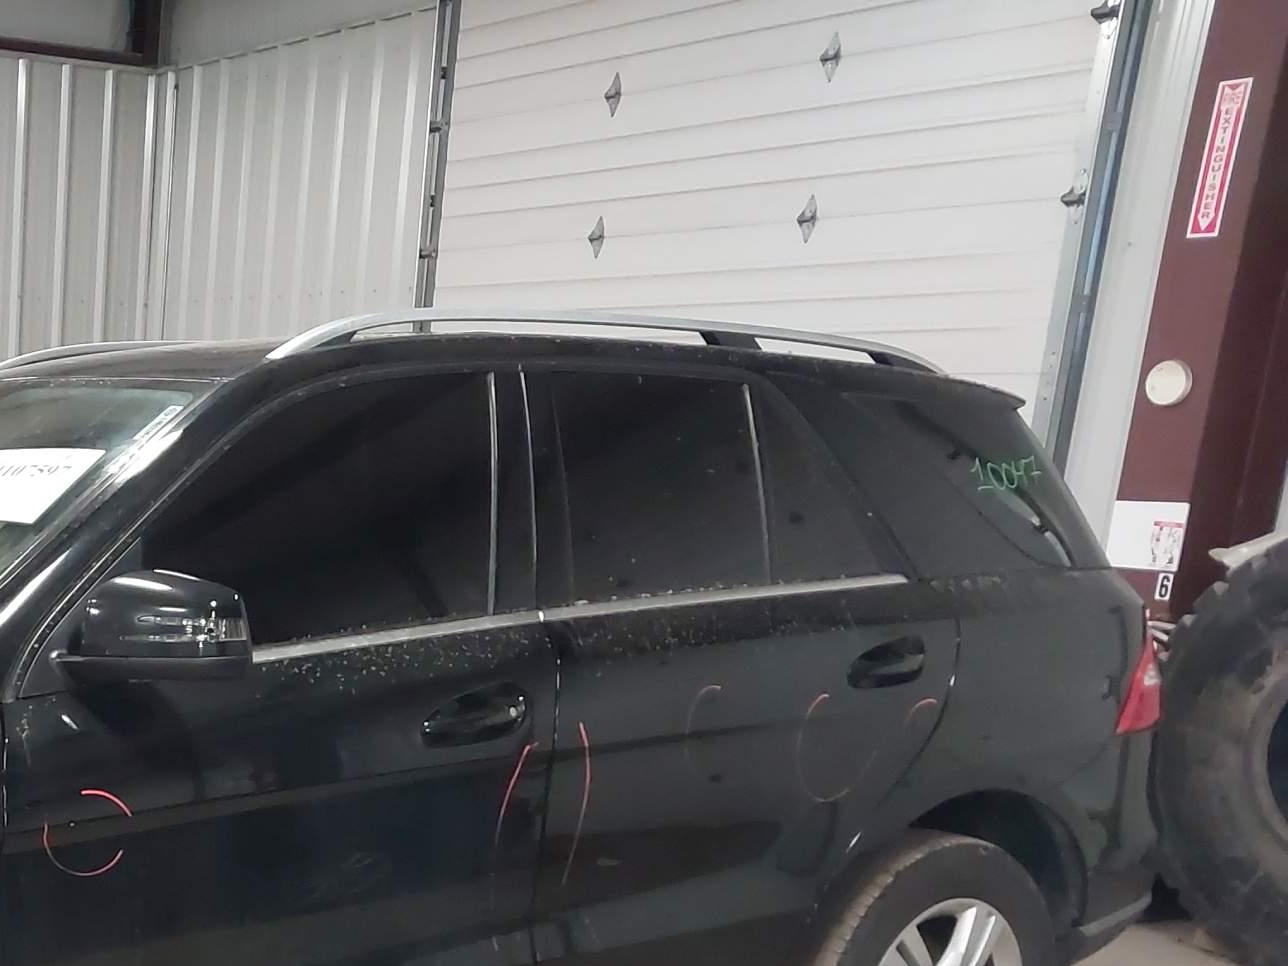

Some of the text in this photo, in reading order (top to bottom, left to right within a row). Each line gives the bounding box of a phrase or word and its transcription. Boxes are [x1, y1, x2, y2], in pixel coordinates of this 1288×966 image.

[1200, 107, 1233, 219] EXTINGUISHER
[969, 455, 1042, 490] 10047
[1158, 575, 1171, 598] 6
